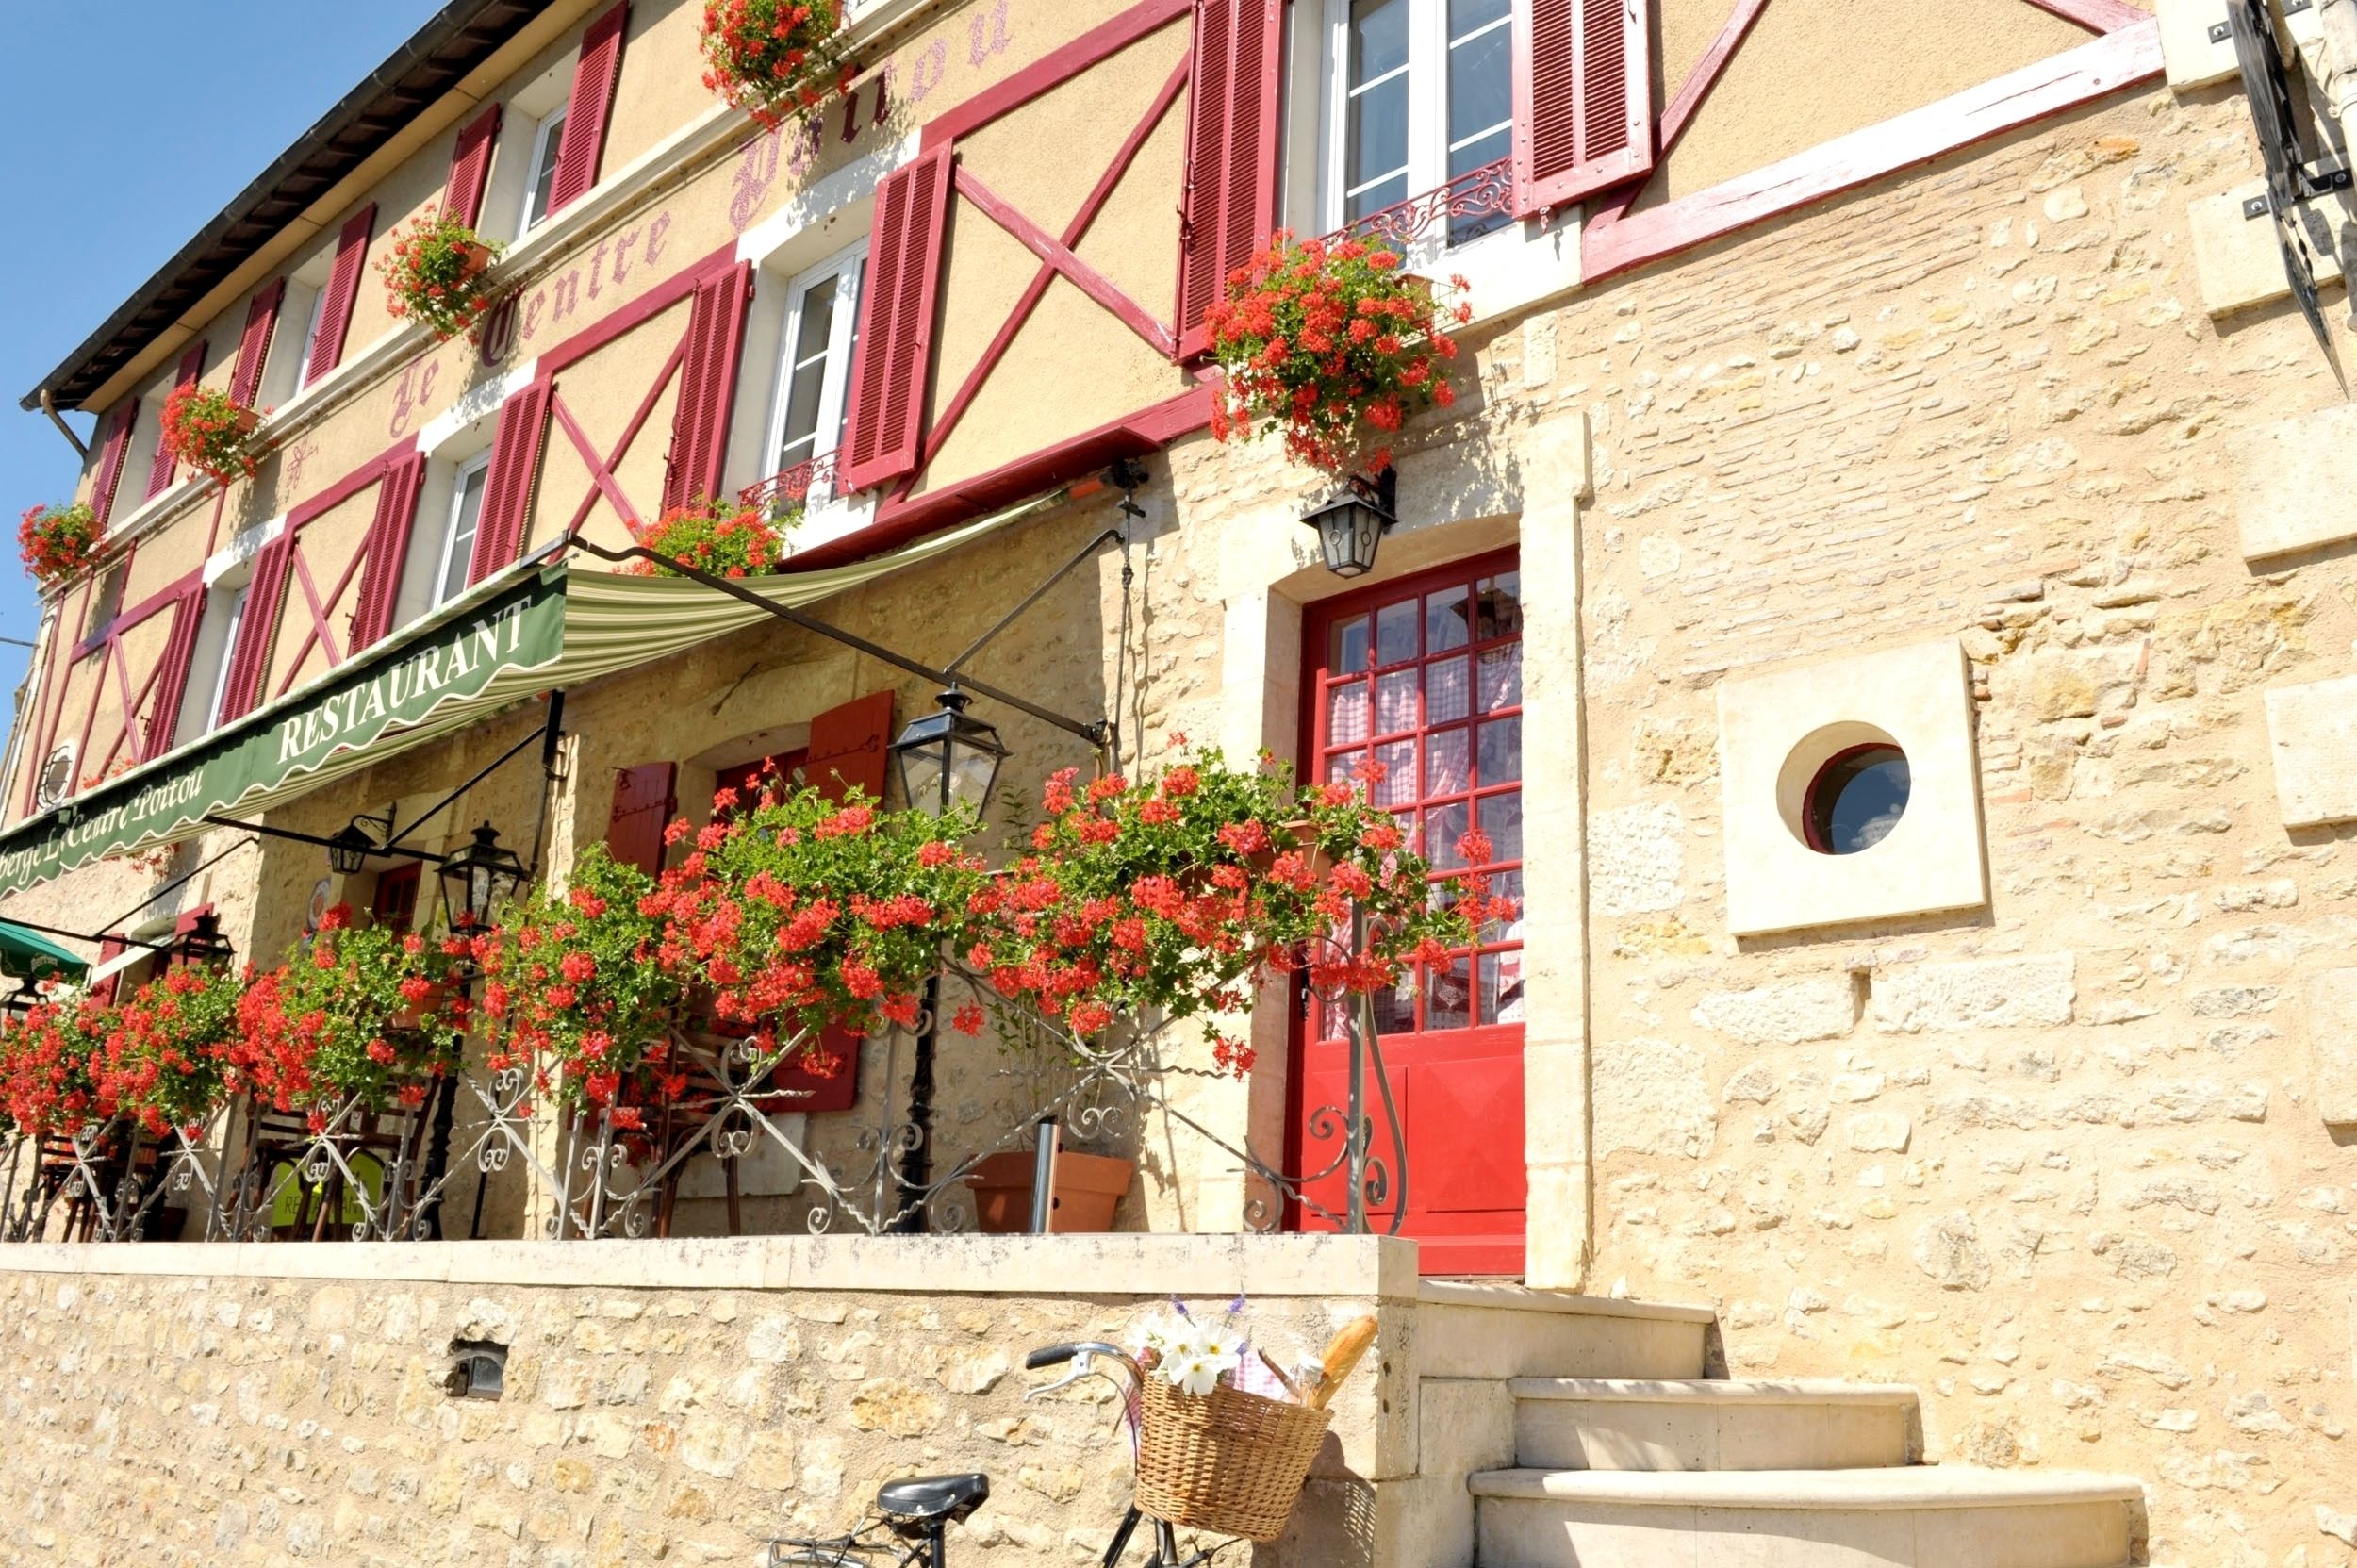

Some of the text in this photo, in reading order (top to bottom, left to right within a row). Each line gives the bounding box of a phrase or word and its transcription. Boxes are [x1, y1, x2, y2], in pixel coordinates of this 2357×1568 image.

[481, 210, 671, 368] Centre
[275, 595, 533, 765] RESTAURANT
[67, 805, 129, 848] Centre
[131, 769, 204, 822] Poitou
